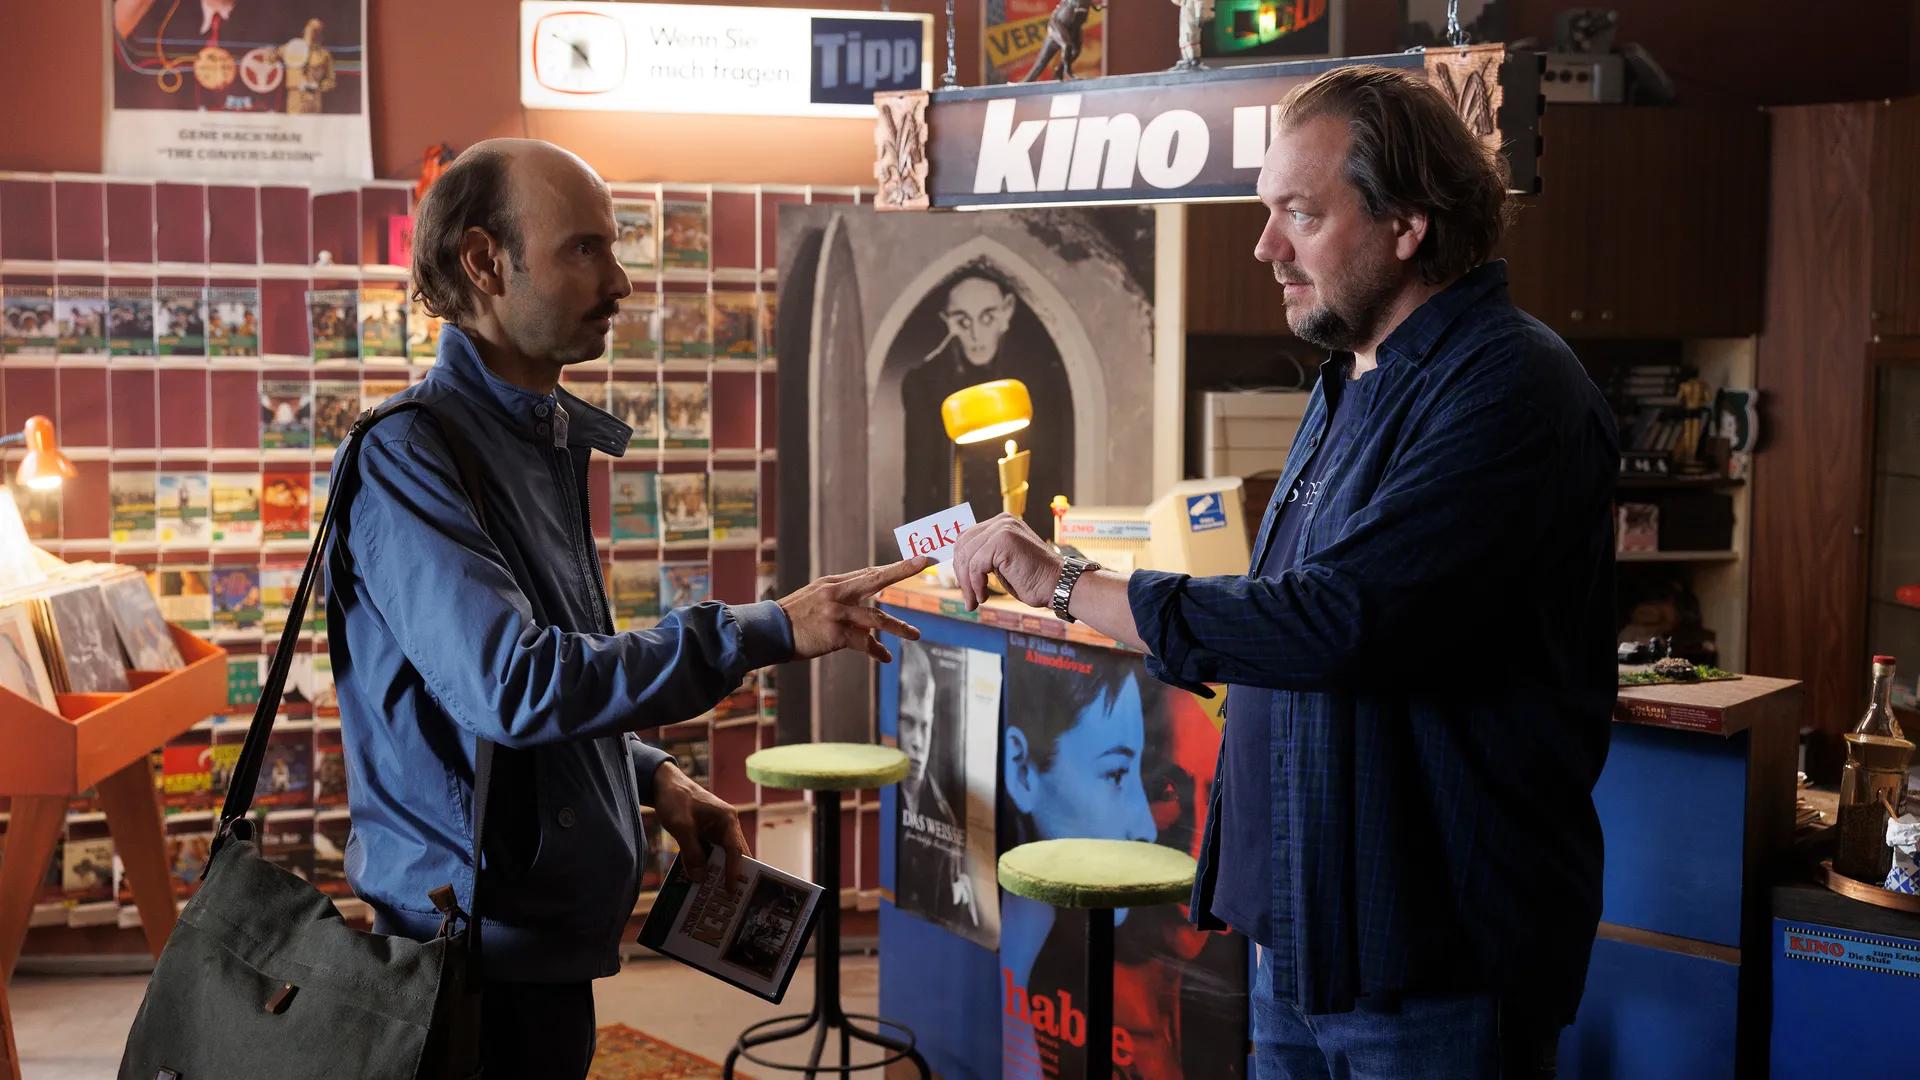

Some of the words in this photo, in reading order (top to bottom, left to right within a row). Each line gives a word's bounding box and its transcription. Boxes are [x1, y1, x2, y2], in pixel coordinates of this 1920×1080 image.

[650, 26, 718, 48] Wenn
[726, 27, 758, 50] Sie
[651, 58, 704, 80] mich
[814, 32, 917, 89] Tipp
[178, 128, 219, 142] GENE
[222, 128, 302, 143] HACKMAN
[973, 94, 1210, 195] kino
[907, 519, 970, 559] fakt
[1790, 936, 1844, 957] KINO
[1872, 949, 1893, 959] zum
[1848, 952, 1865, 961] Die
[1865, 954, 1892, 965] Stufe
[1002, 967, 1135, 1066] habe
